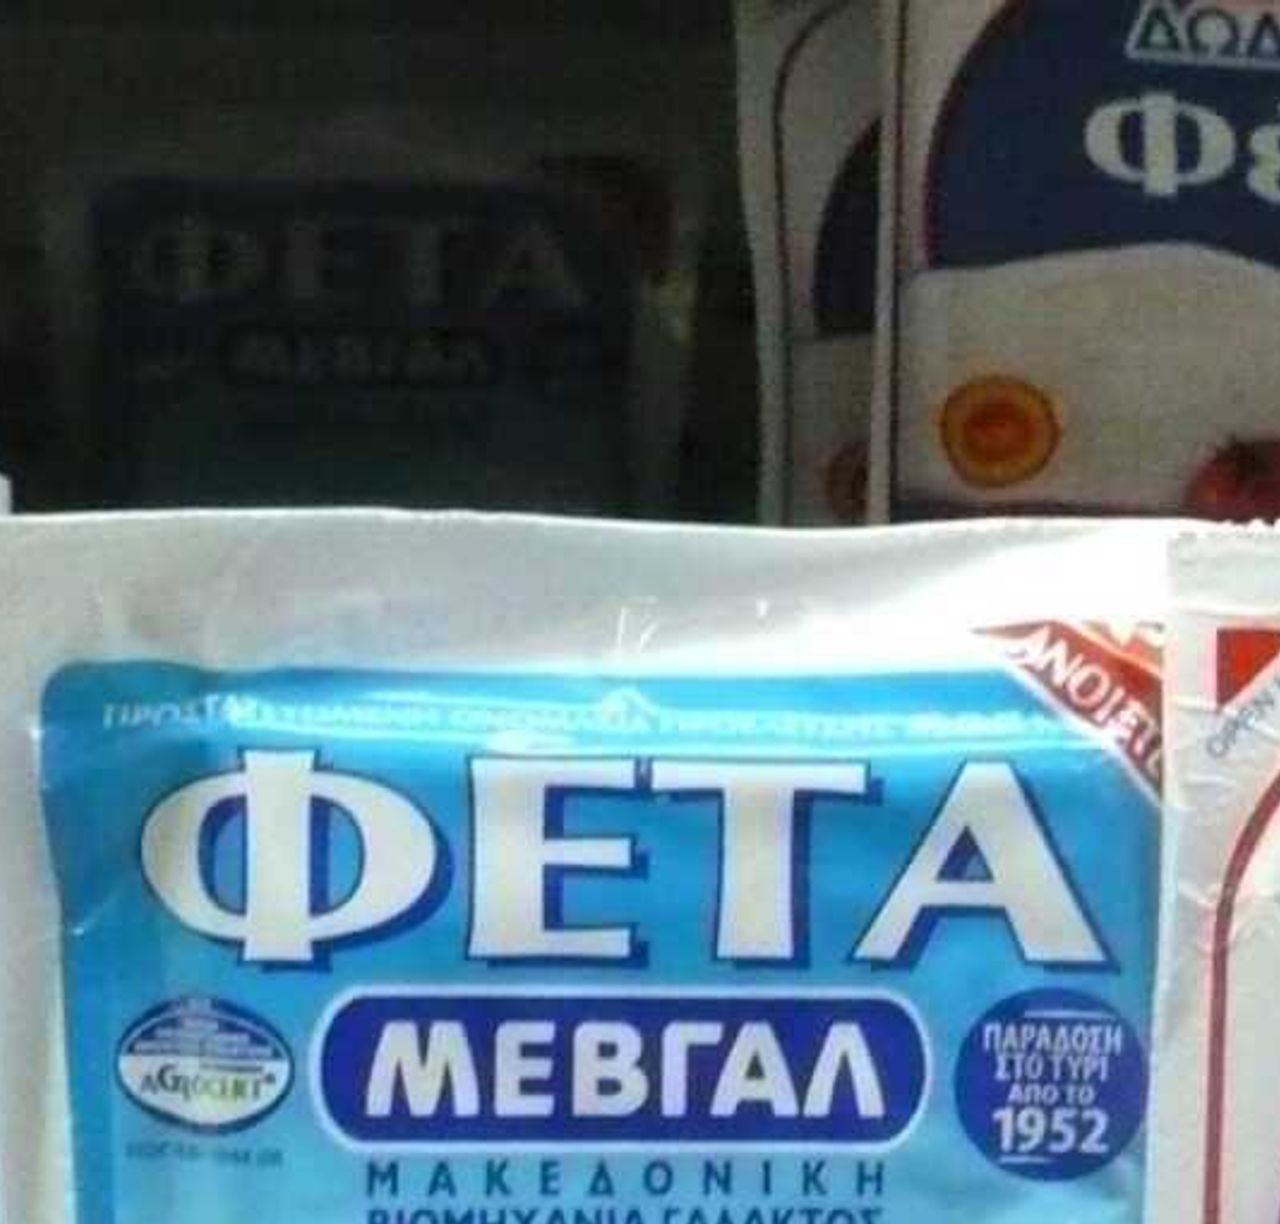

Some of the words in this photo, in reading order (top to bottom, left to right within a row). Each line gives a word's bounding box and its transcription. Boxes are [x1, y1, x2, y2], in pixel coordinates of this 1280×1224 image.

[140, 750, 1112, 962] ΦΕΤΑ
[983, 1022, 1122, 1056] ΠΑΡΑΔΟΣΗ
[364, 1020, 887, 1118] ΜΕΒΓΑΛ
[995, 1055, 1046, 1082] ΣΤΟ
[1052, 1054, 1110, 1082] ΤΥΡΙ
[1008, 1083, 1059, 1105] ΑΠΟ
[1064, 1085, 1096, 1105] ΤΟ
[990, 1107, 1110, 1155] 1952
[365, 1158, 885, 1198] ΜΑΚΕΔΟΝΙΚΗ
